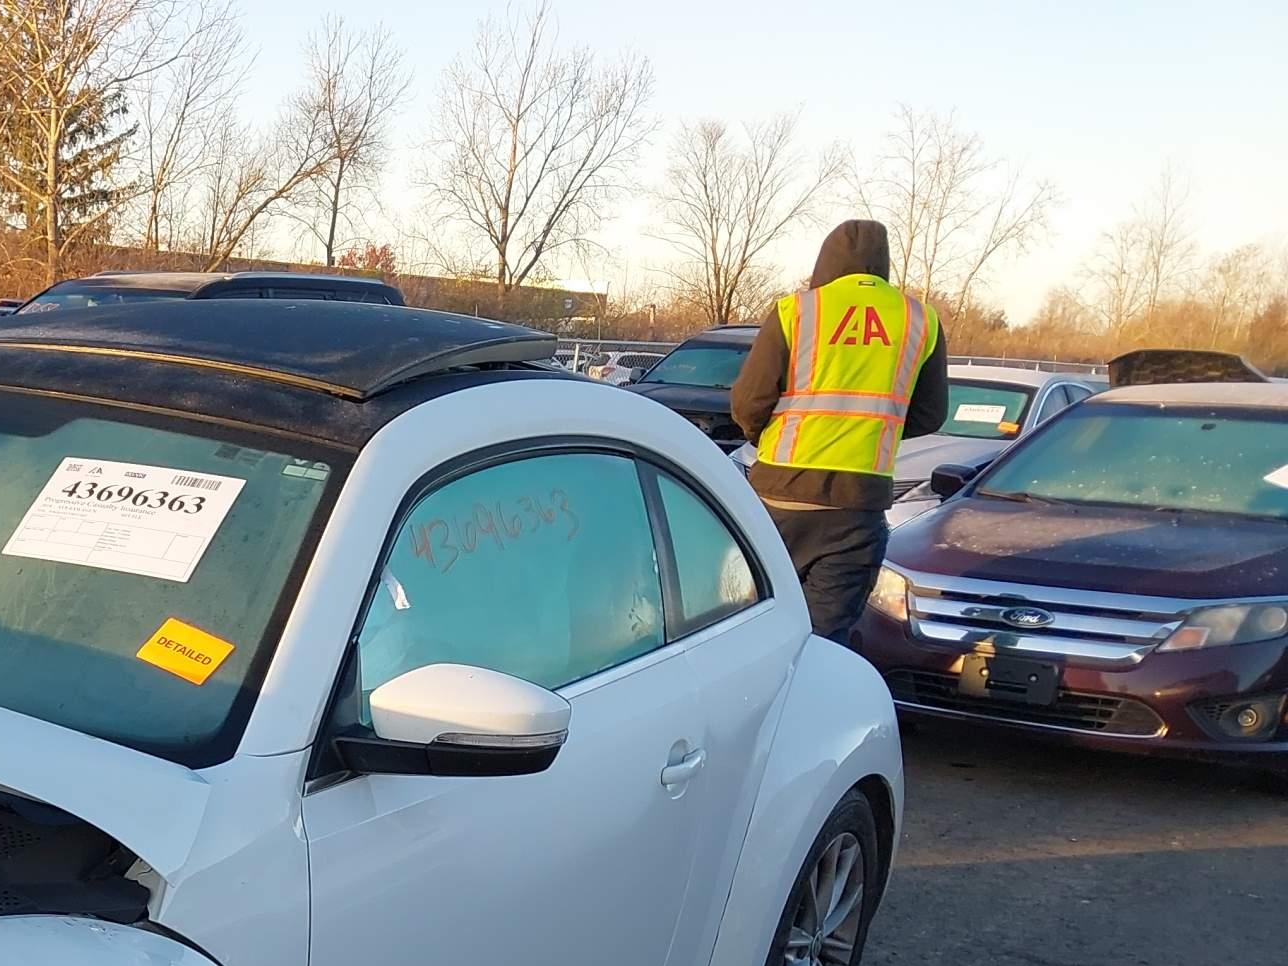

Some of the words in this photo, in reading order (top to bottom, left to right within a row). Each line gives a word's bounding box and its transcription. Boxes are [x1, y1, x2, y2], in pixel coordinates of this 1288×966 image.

[62, 480, 207, 515] 43696363
[1010, 609, 1041, 624] Ford
[156, 636, 212, 666] DETAILED
